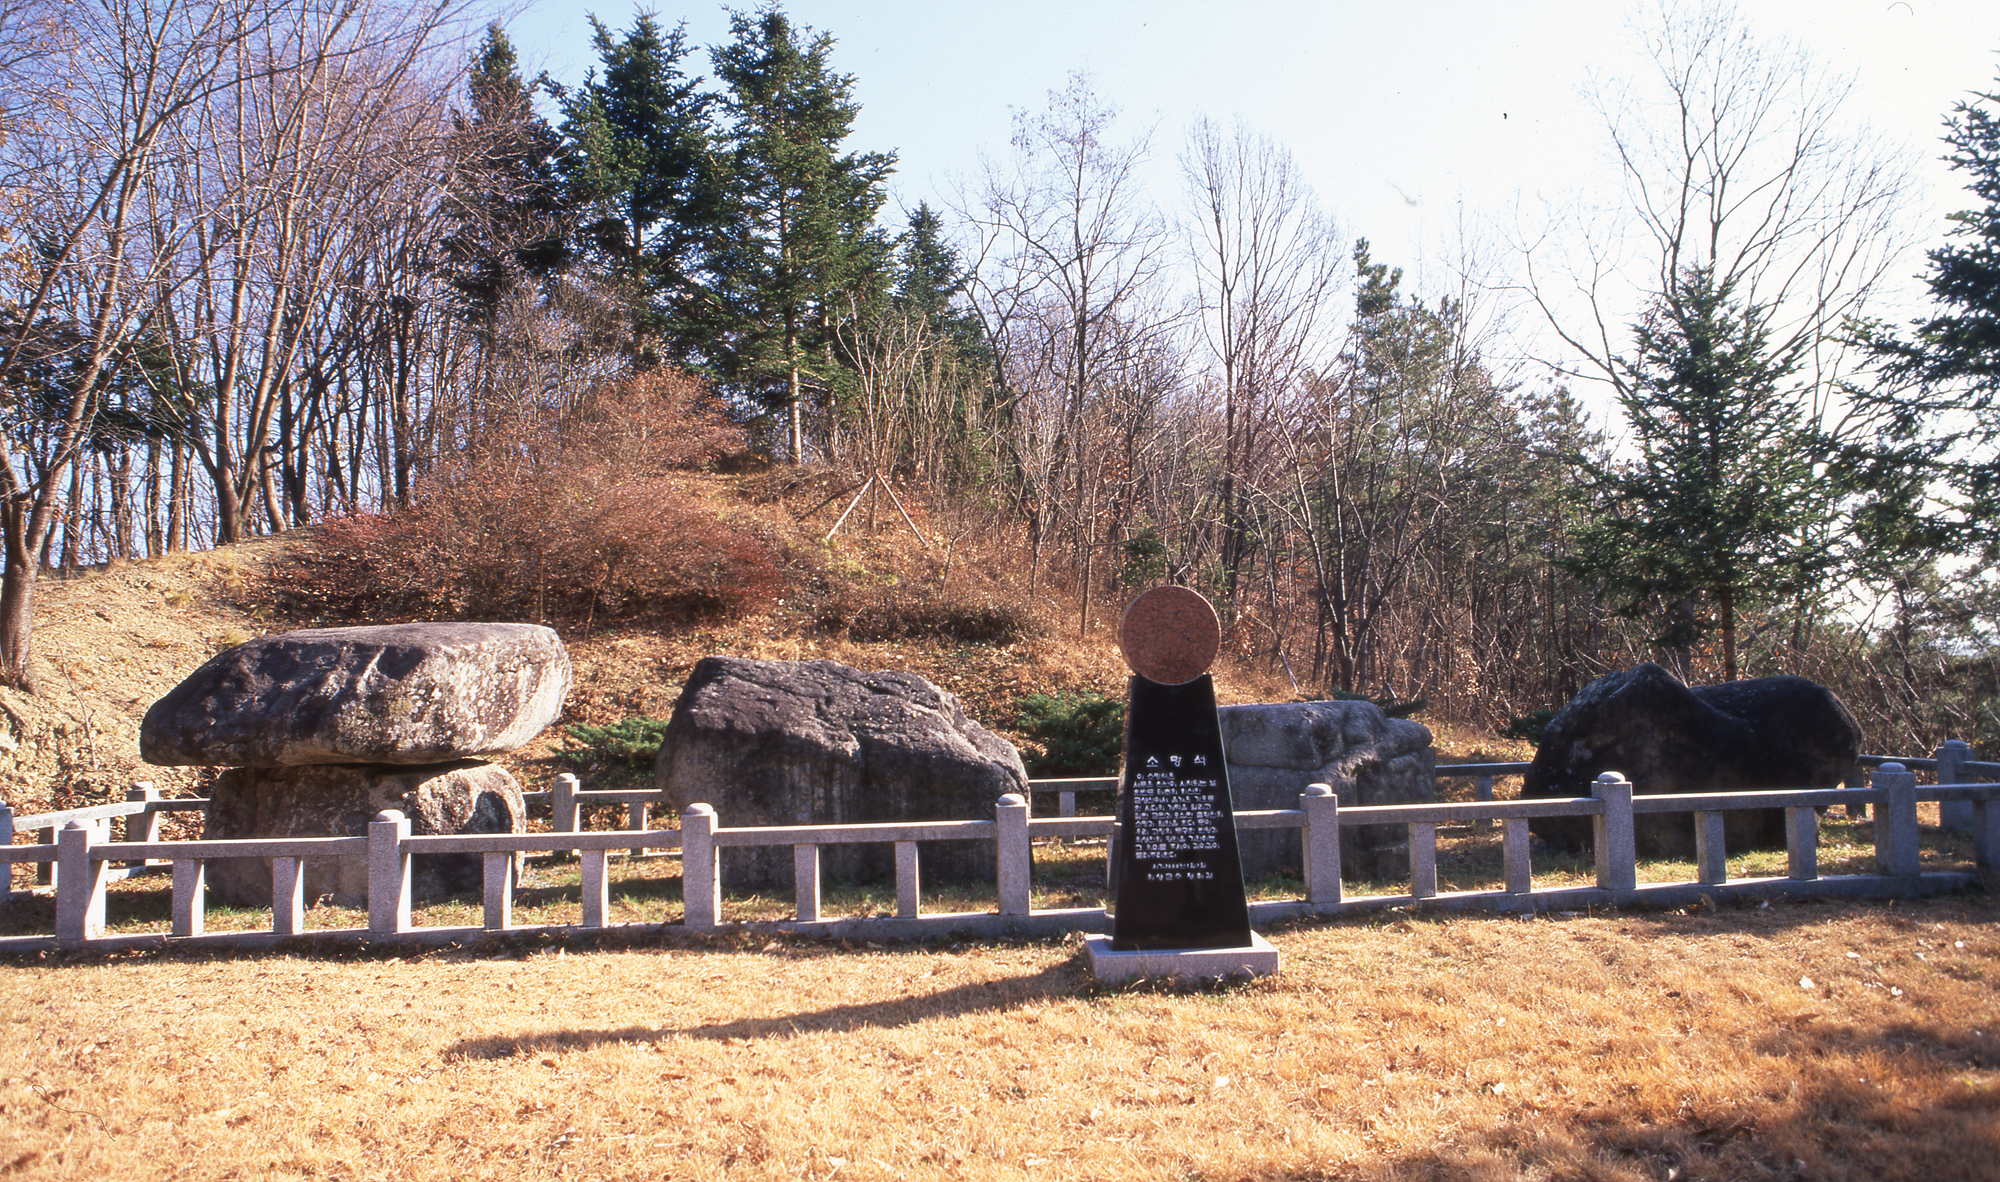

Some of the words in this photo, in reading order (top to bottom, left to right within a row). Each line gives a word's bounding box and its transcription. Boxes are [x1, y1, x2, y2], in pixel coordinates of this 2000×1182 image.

[1147, 772, 1175, 780] 소망석은
[1156, 780, 1177, 788] 천년이
[1133, 788, 1154, 796] 한반도
[1133, 796, 1169, 804] 금성산에서
[1134, 804, 1142, 812] 한
[1144, 804, 1165, 812] 시대의
[1190, 803, 1212, 811] 알리고
[1151, 812, 1172, 820] 군민과
[1135, 820, 1155, 828] 소망과
[1135, 827, 1149, 835] 우리
[1151, 827, 1173, 835] 고장의
[1135, 843, 1143, 851] 그
